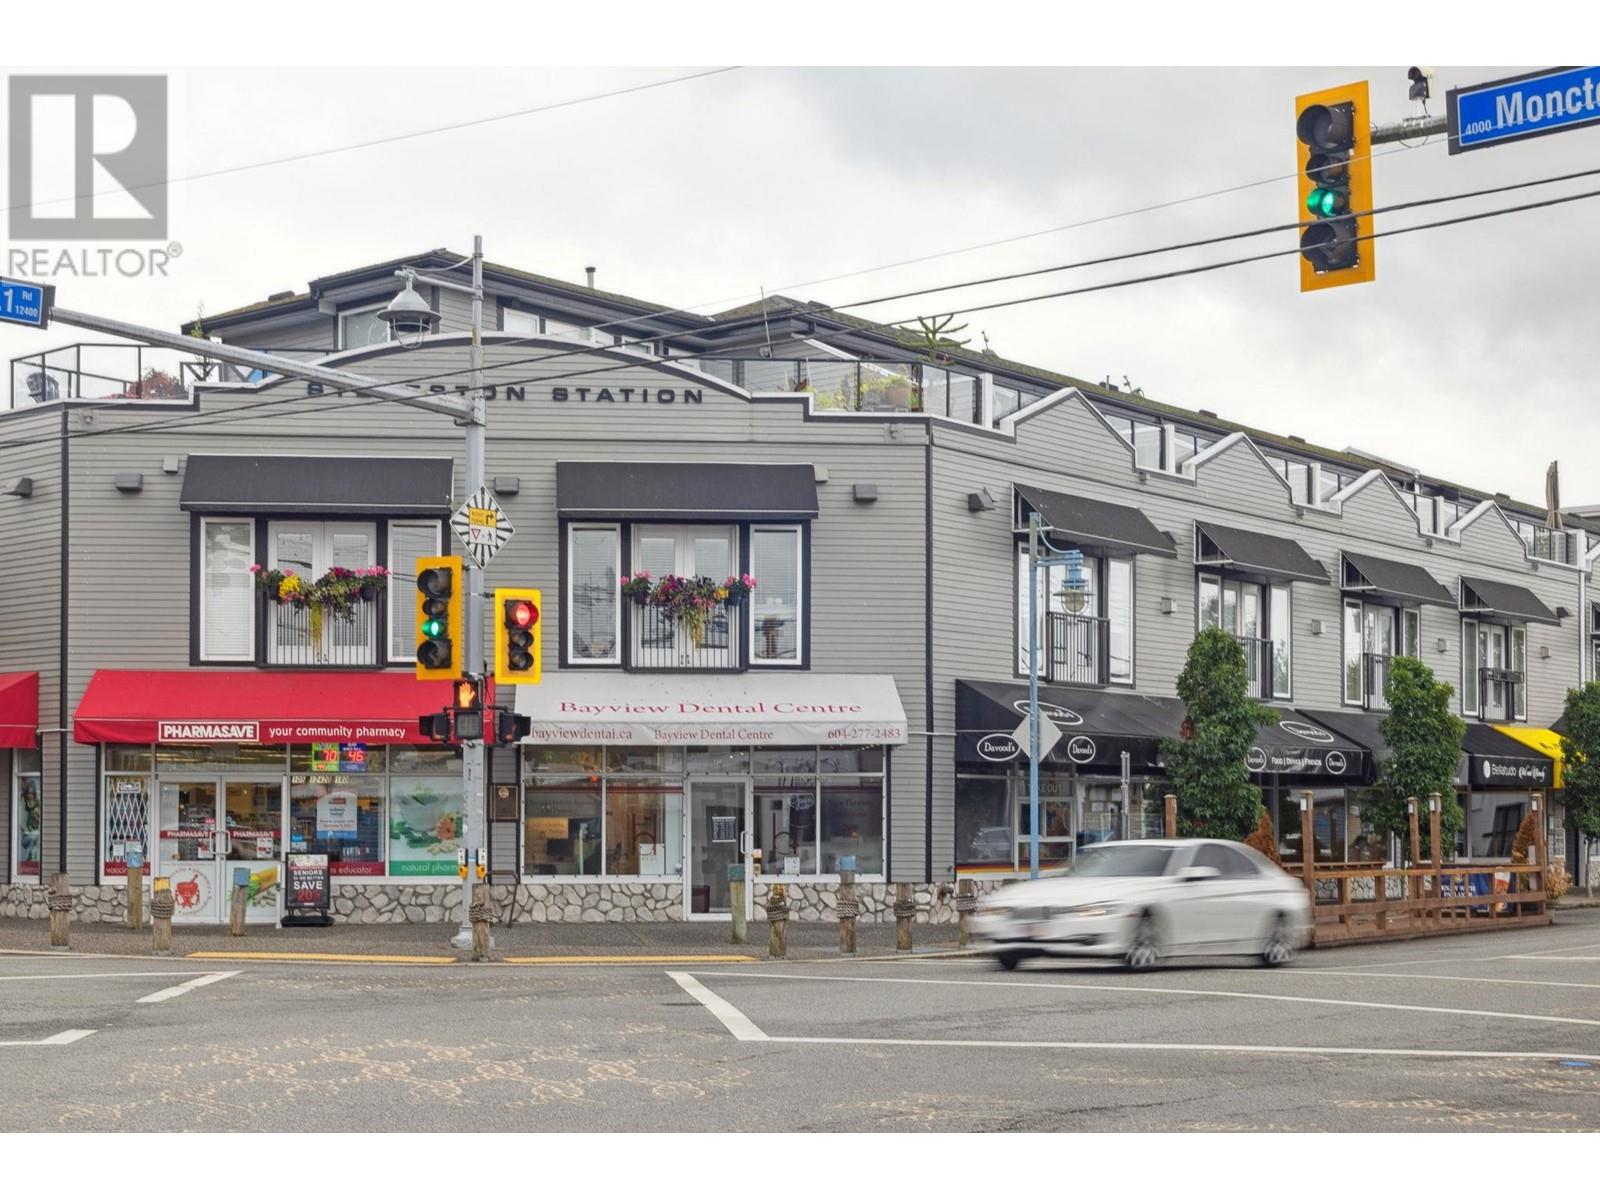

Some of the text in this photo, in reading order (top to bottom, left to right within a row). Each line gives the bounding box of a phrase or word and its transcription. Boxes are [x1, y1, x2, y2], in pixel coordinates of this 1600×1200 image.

[1464, 77, 1600, 136] 4000 Monct
[22, 289, 33, 301] Rd
[15, 304, 39, 318] 12400
[552, 387, 703, 404] STATION
[559, 701, 863, 716] Bayview Dental Centre
[163, 724, 255, 739] PHARMASAVE
[269, 726, 406, 738] your community pharmacy
[531, 727, 774, 742] bayviewdental.ca Bayview Dental Centre
[827, 728, 901, 740] 604-277-2483
[984, 741, 1016, 753] Davood's
[167, 830, 209, 838] PHARMASAVE
[233, 830, 274, 838] PHARMASAVE
[338, 864, 373, 874] educator
[401, 862, 460, 874] natural pharm
[293, 881, 324, 890] SAVE
